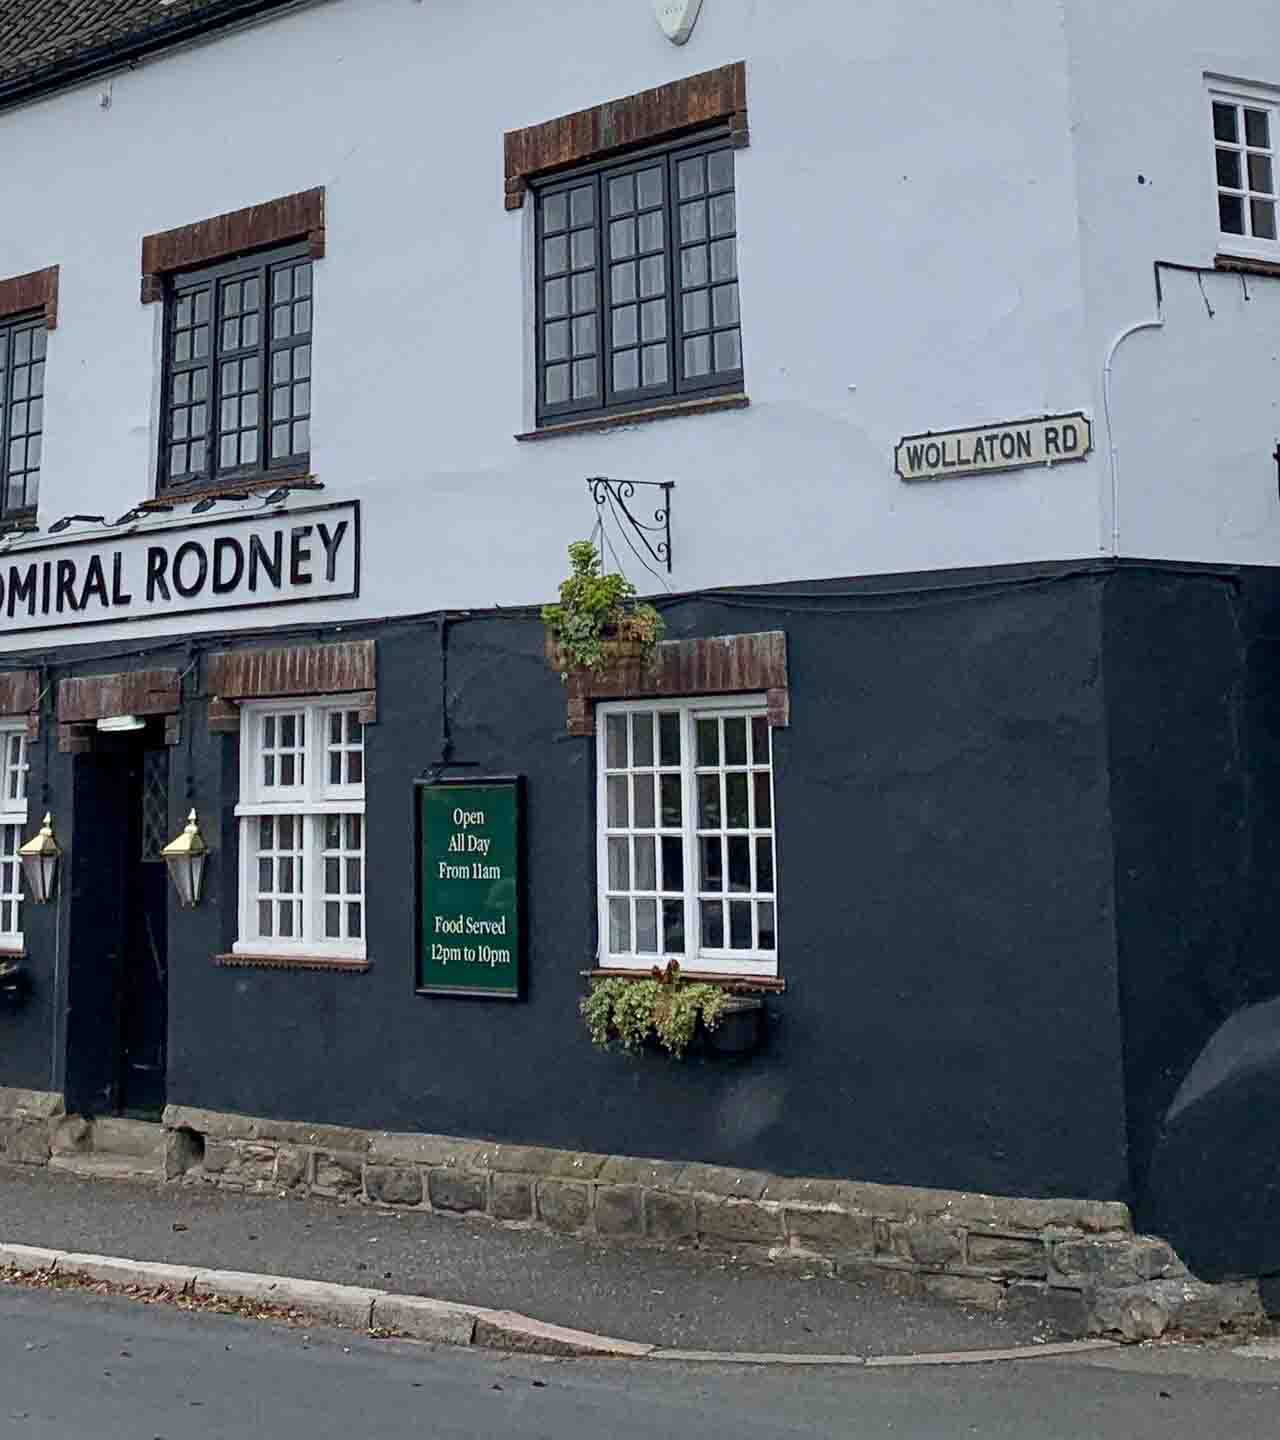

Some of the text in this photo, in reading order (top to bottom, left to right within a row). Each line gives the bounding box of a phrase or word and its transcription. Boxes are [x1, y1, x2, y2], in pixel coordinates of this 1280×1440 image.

[906, 424, 1078, 472] WOLLATON RD
[145, 520, 349, 602] RODNEY
[453, 808, 484, 828] Open
[448, 833, 490, 856] All Day
[438, 862, 501, 880] From 11am
[434, 915, 506, 935] Food Served
[431, 944, 511, 967] 12pm to 10pm
